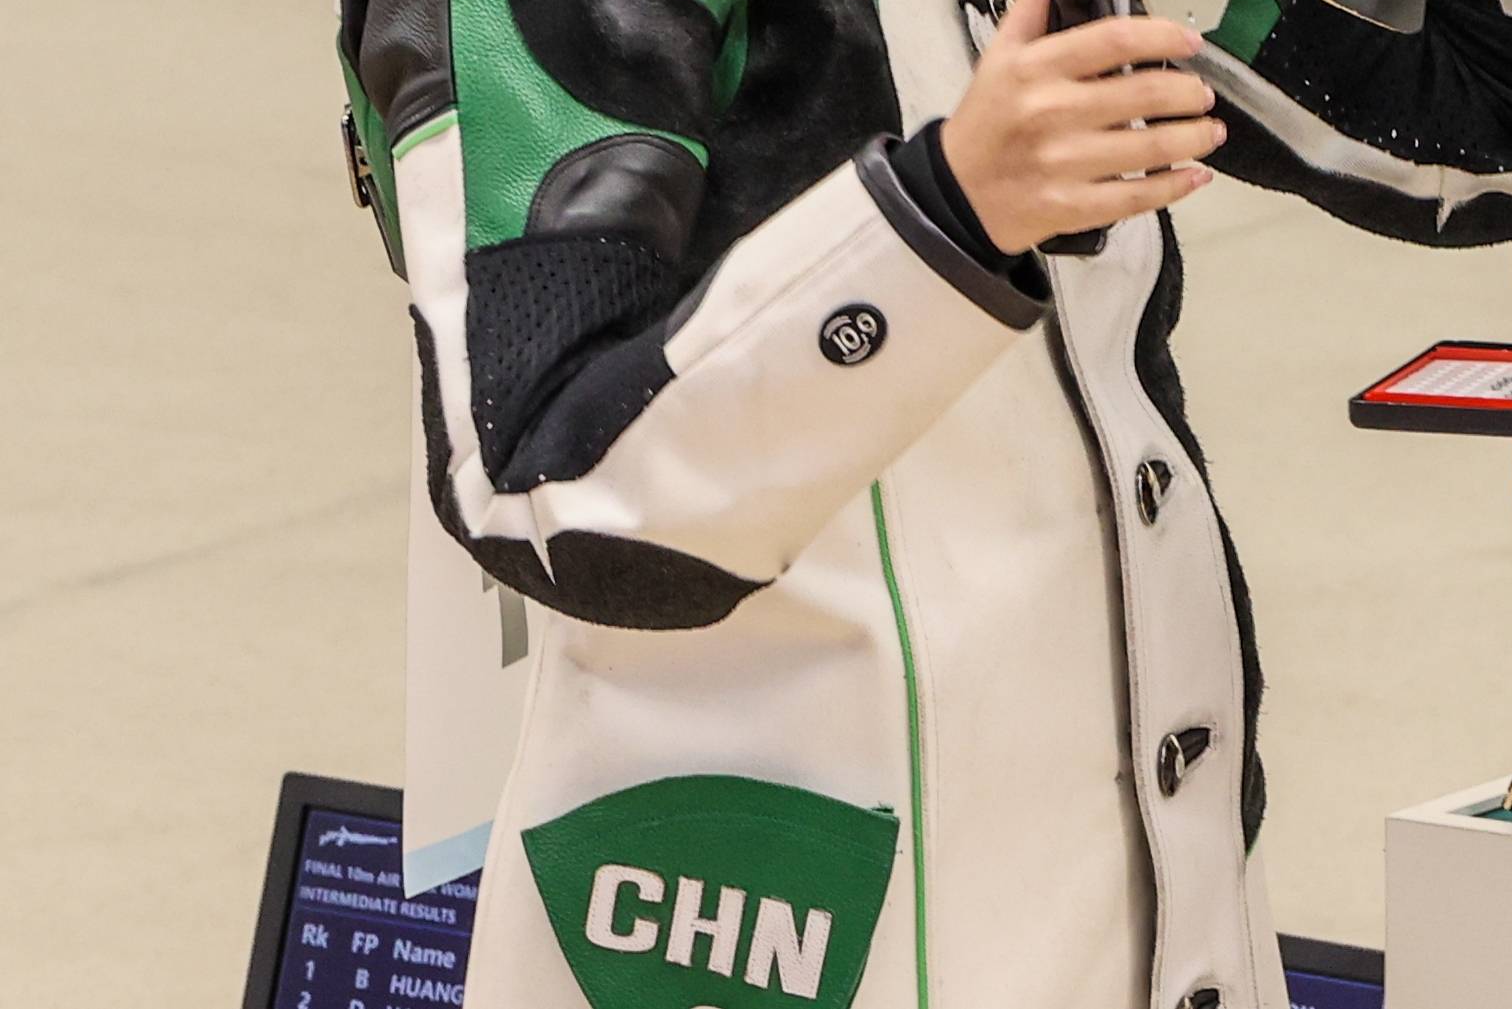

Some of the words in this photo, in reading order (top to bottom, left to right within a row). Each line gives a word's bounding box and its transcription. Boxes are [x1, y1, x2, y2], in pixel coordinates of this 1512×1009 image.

[304, 859, 343, 879] FINAL
[377, 871, 401, 888] AIR
[299, 885, 399, 915] INTERMEDIATE
[399, 903, 457, 924] RESULTS
[301, 923, 329, 949] Rk
[351, 931, 379, 954] FP
[393, 938, 456, 969] Name
[585, 863, 832, 999] CHN
[305, 960, 315, 980] 1
[355, 967, 370, 989] B
[390, 974, 464, 1005] HUANG
